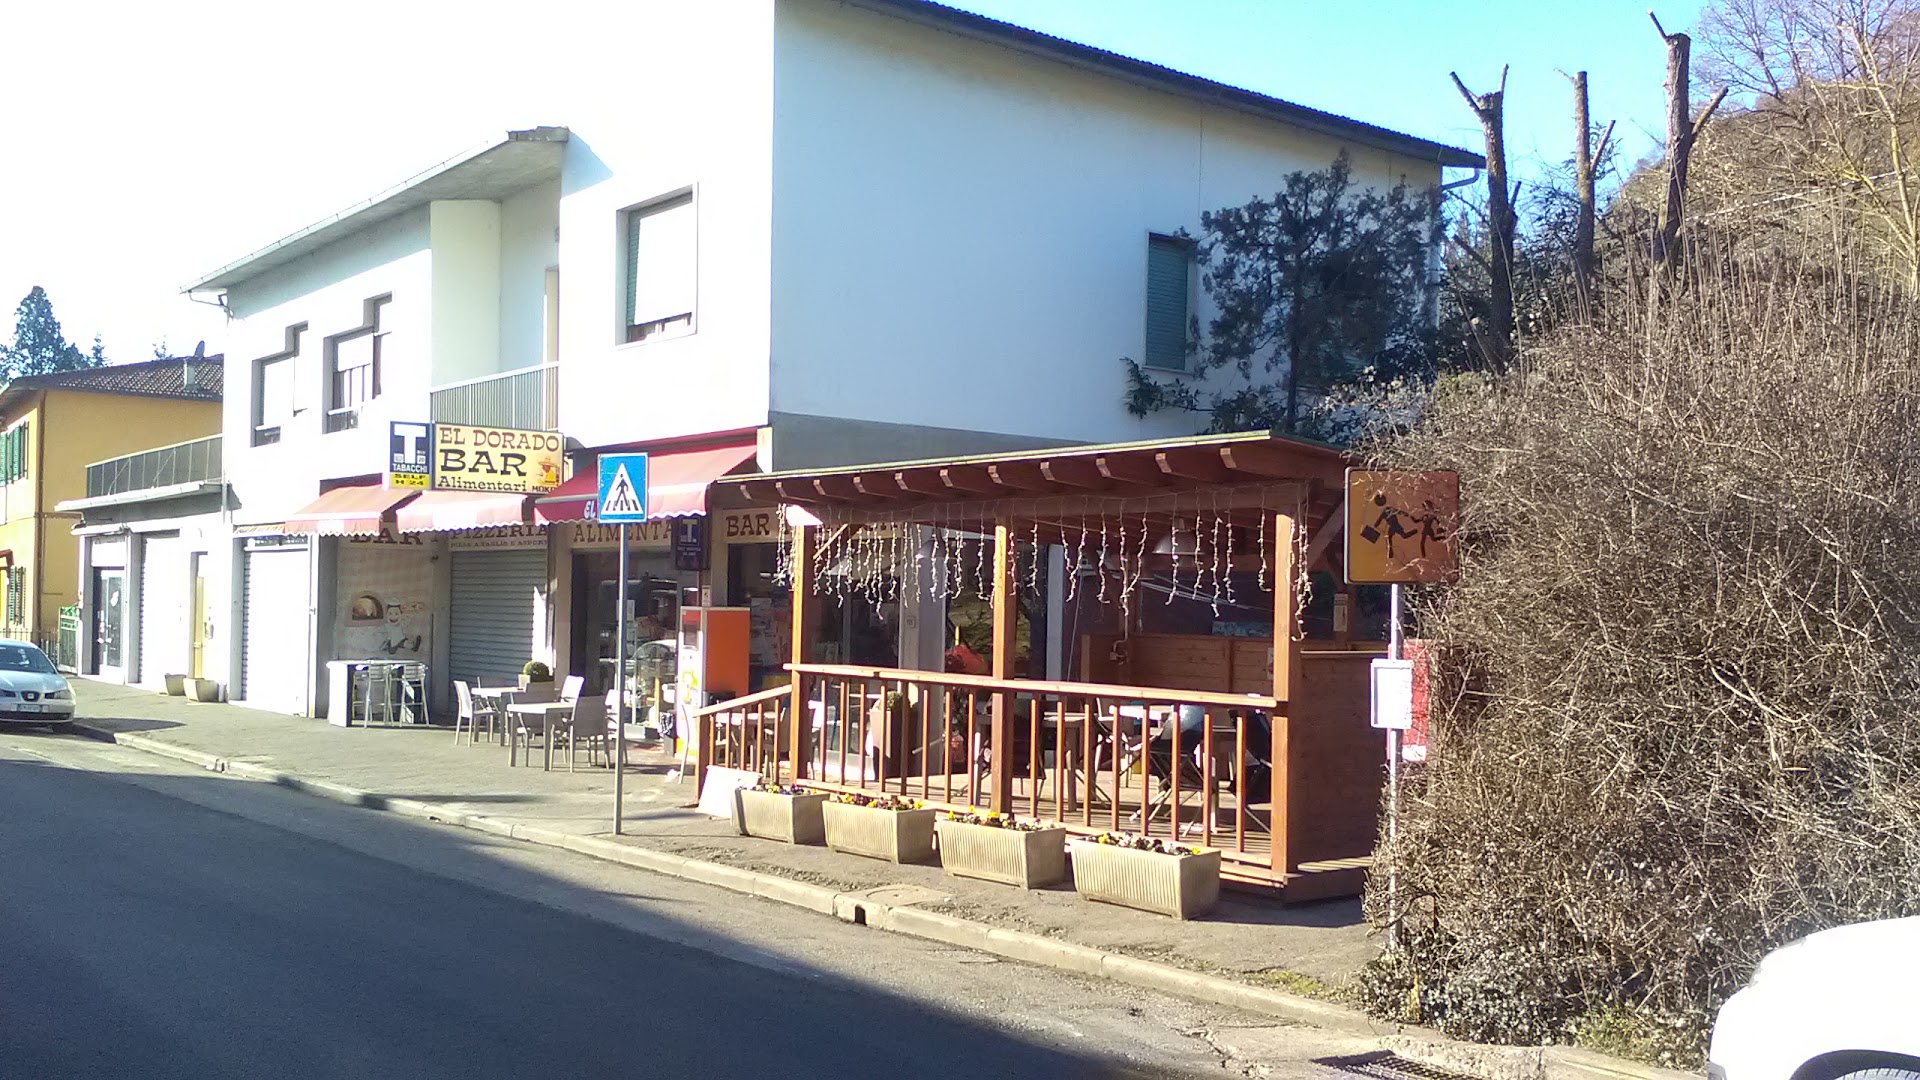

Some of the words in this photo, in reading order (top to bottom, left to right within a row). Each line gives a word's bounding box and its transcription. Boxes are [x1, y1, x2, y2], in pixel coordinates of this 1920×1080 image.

[394, 424, 426, 464] T
[440, 427, 466, 445] EL
[473, 429, 560, 452] DORADO
[392, 463, 428, 473] TABACCHI
[439, 448, 528, 477] BAR
[437, 476, 528, 493] Alimentari
[450, 524, 548, 540] PIZZERIA
[726, 513, 770, 537] BAR
